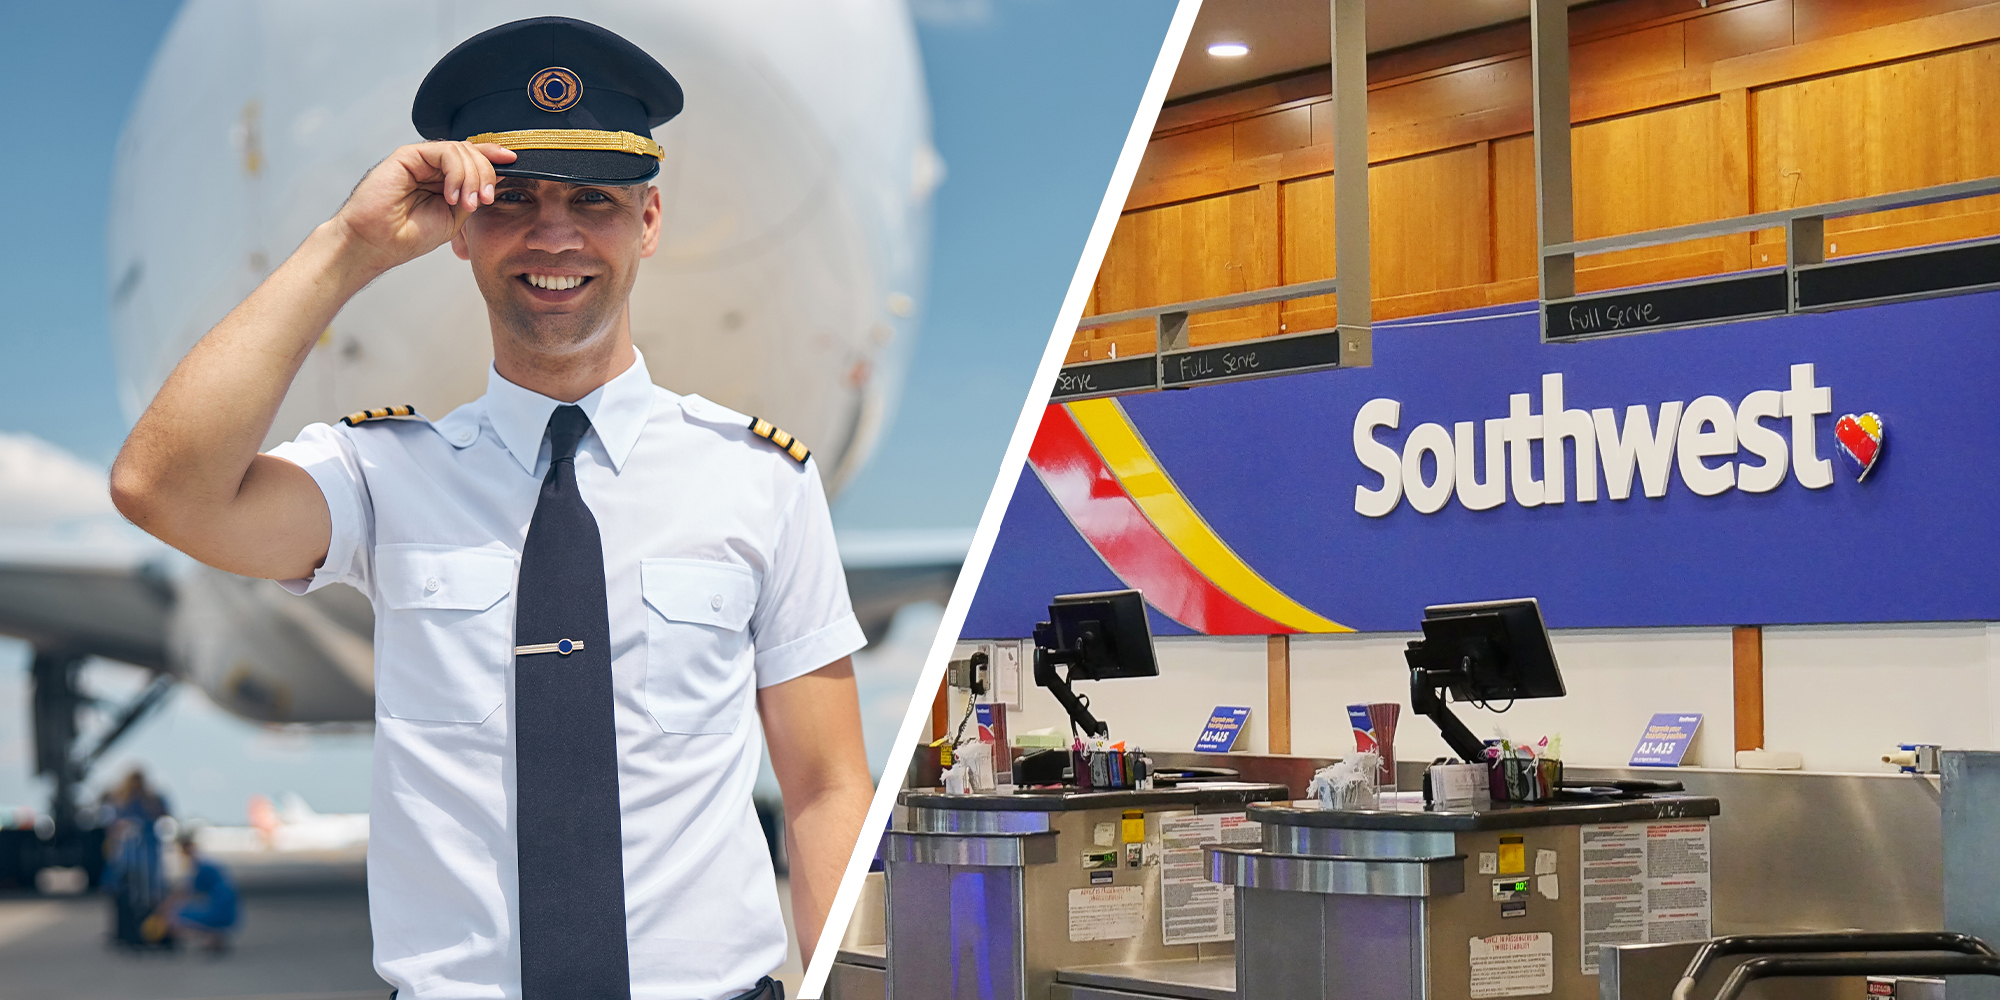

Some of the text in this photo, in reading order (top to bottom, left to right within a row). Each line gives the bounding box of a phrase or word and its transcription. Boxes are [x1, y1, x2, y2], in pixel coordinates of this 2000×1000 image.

[1569, 303, 1660, 331] Full Serve
[1222, 352, 1260, 373] Serve
[1353, 363, 1834, 518] Southwest
[1637, 742, 1676, 755] A1-A15
